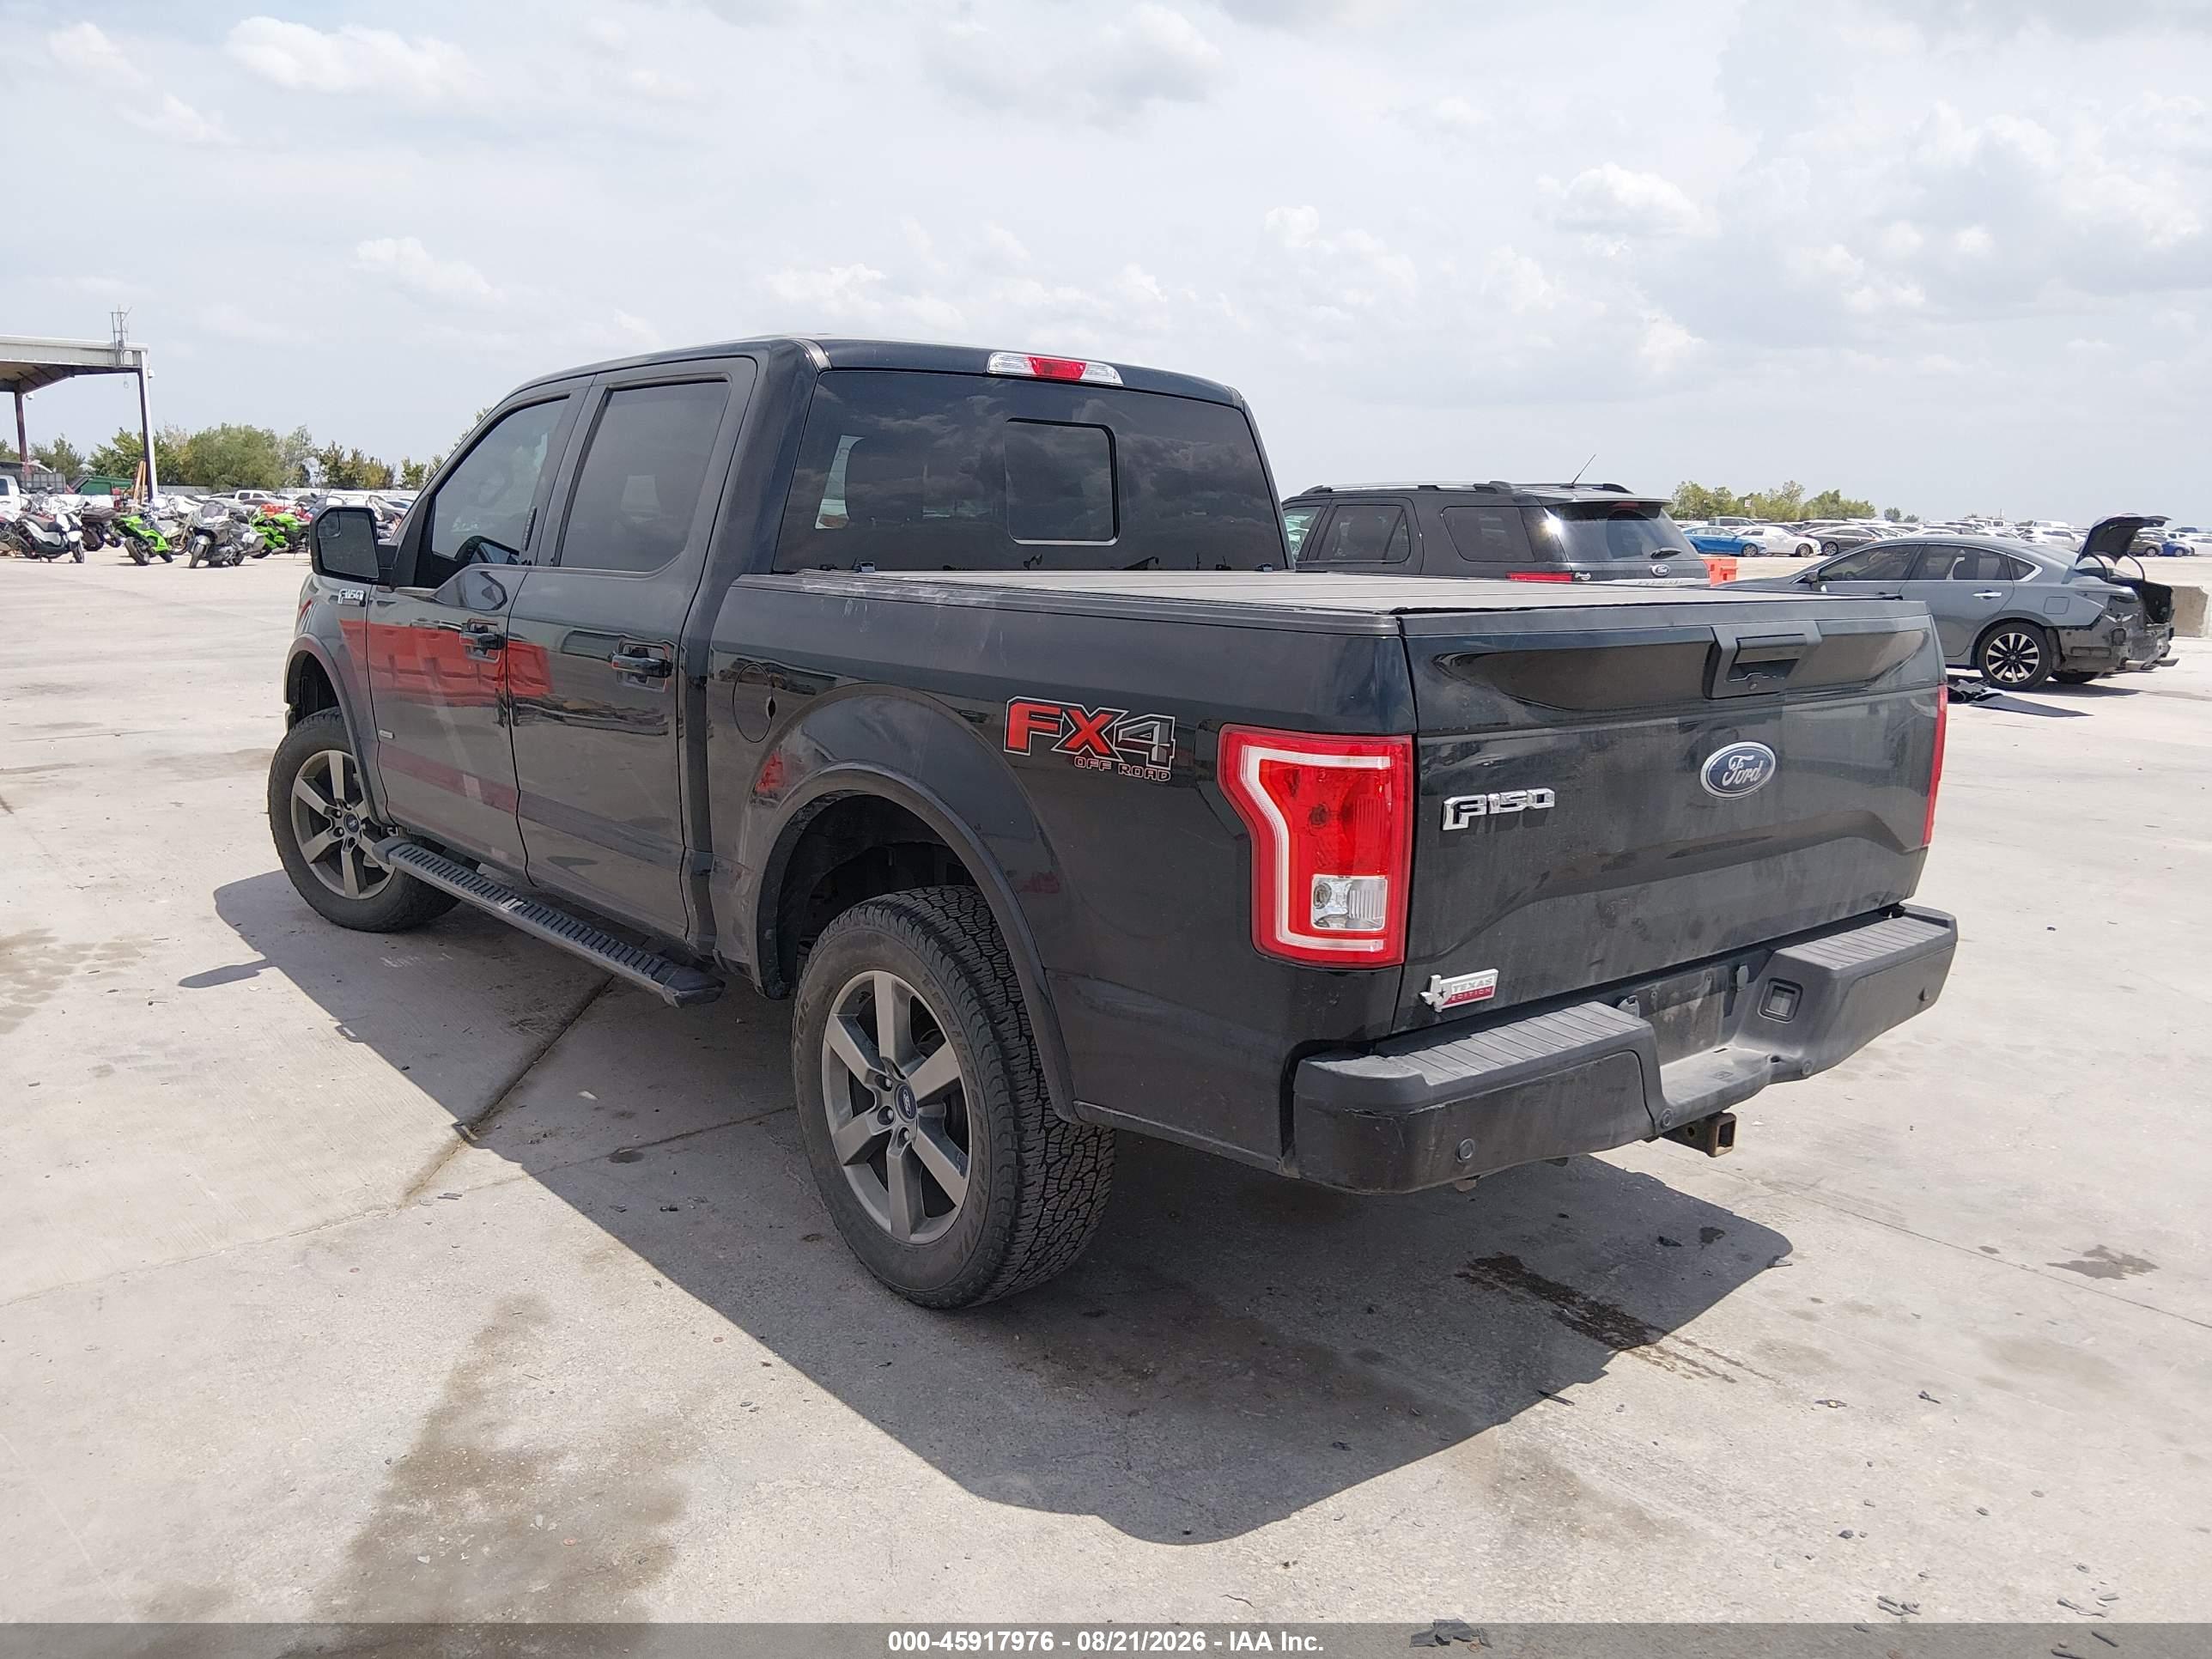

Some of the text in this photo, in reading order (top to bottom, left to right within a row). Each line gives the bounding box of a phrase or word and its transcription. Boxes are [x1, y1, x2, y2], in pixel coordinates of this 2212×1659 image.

[1004, 696, 1176, 770] FX4
[1074, 756, 1170, 781] OFF ROAD
[1722, 755, 1765, 786] Ford
[1451, 988, 1492, 1001] EDITION
[1452, 977, 1493, 994] TEXAS
